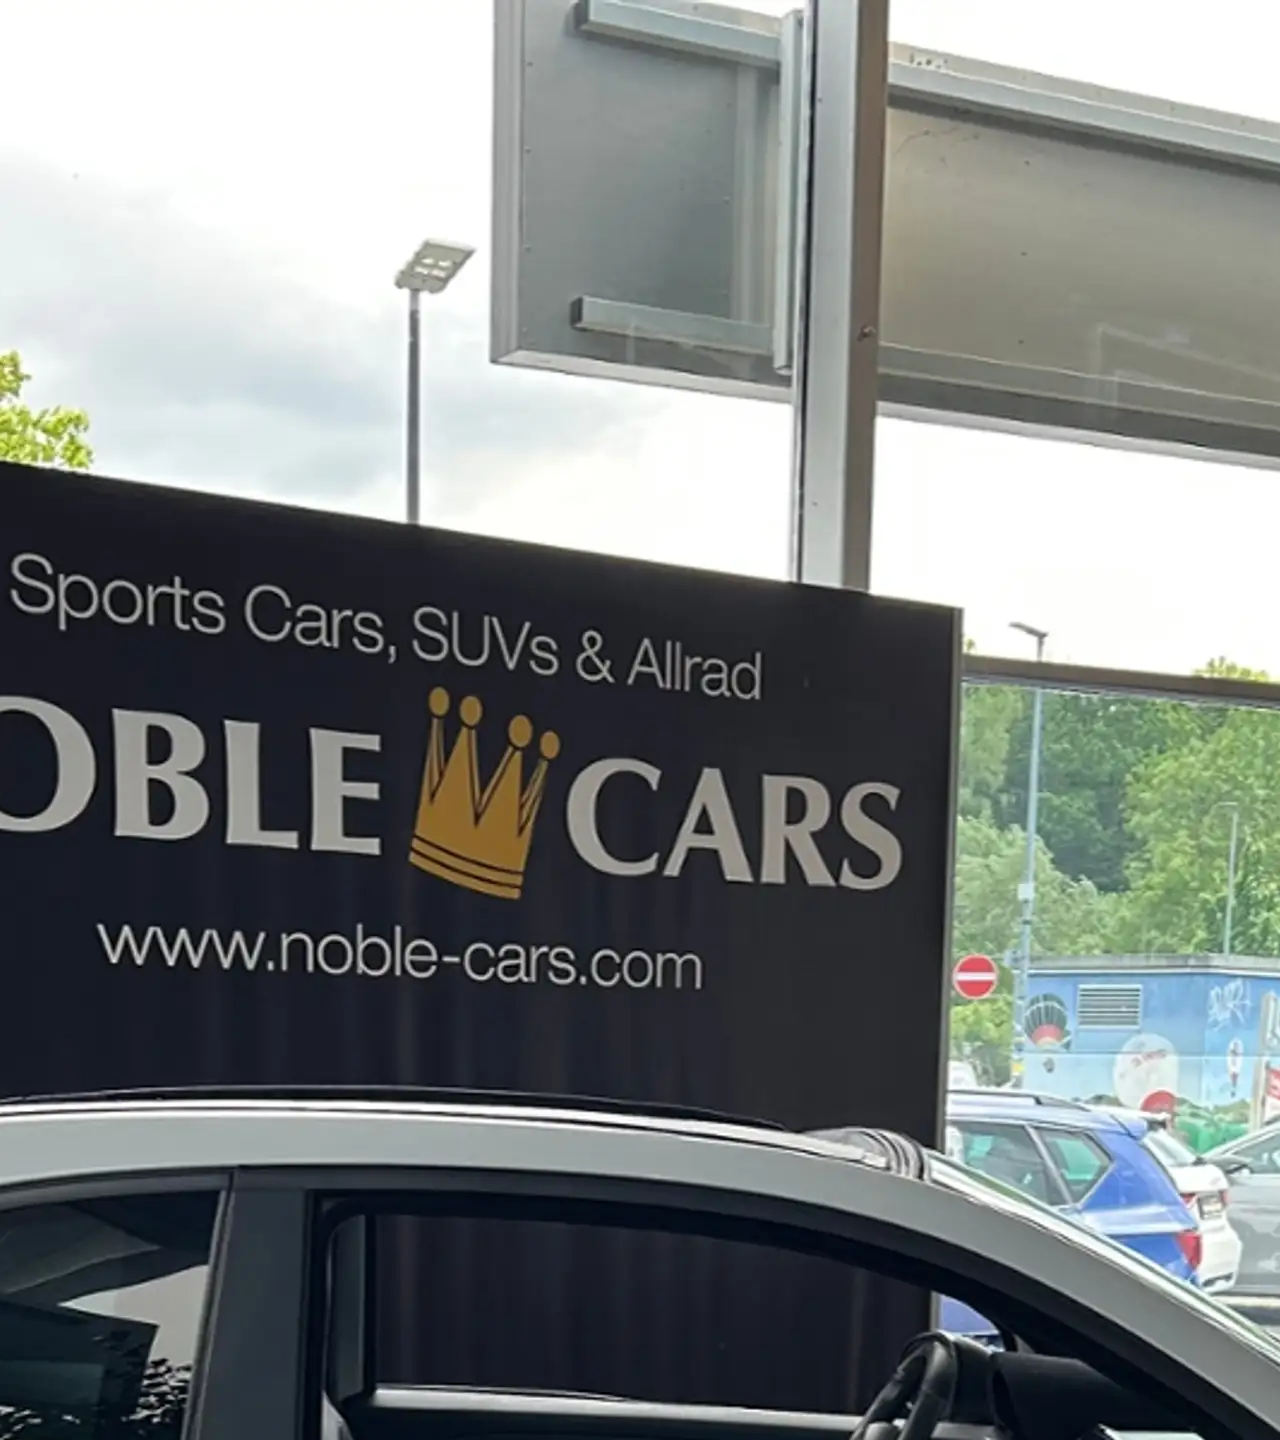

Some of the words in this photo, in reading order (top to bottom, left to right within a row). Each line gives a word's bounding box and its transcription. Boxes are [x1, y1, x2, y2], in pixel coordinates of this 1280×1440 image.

[11, 553, 226, 635] Sports
[245, 585, 397, 664] Cars,
[412, 606, 559, 676] SUVs
[576, 630, 615, 684] &
[627, 638, 762, 701] Allrad
[567, 758, 902, 891] CARS
[96, 923, 703, 990] www.noble-cars.com
